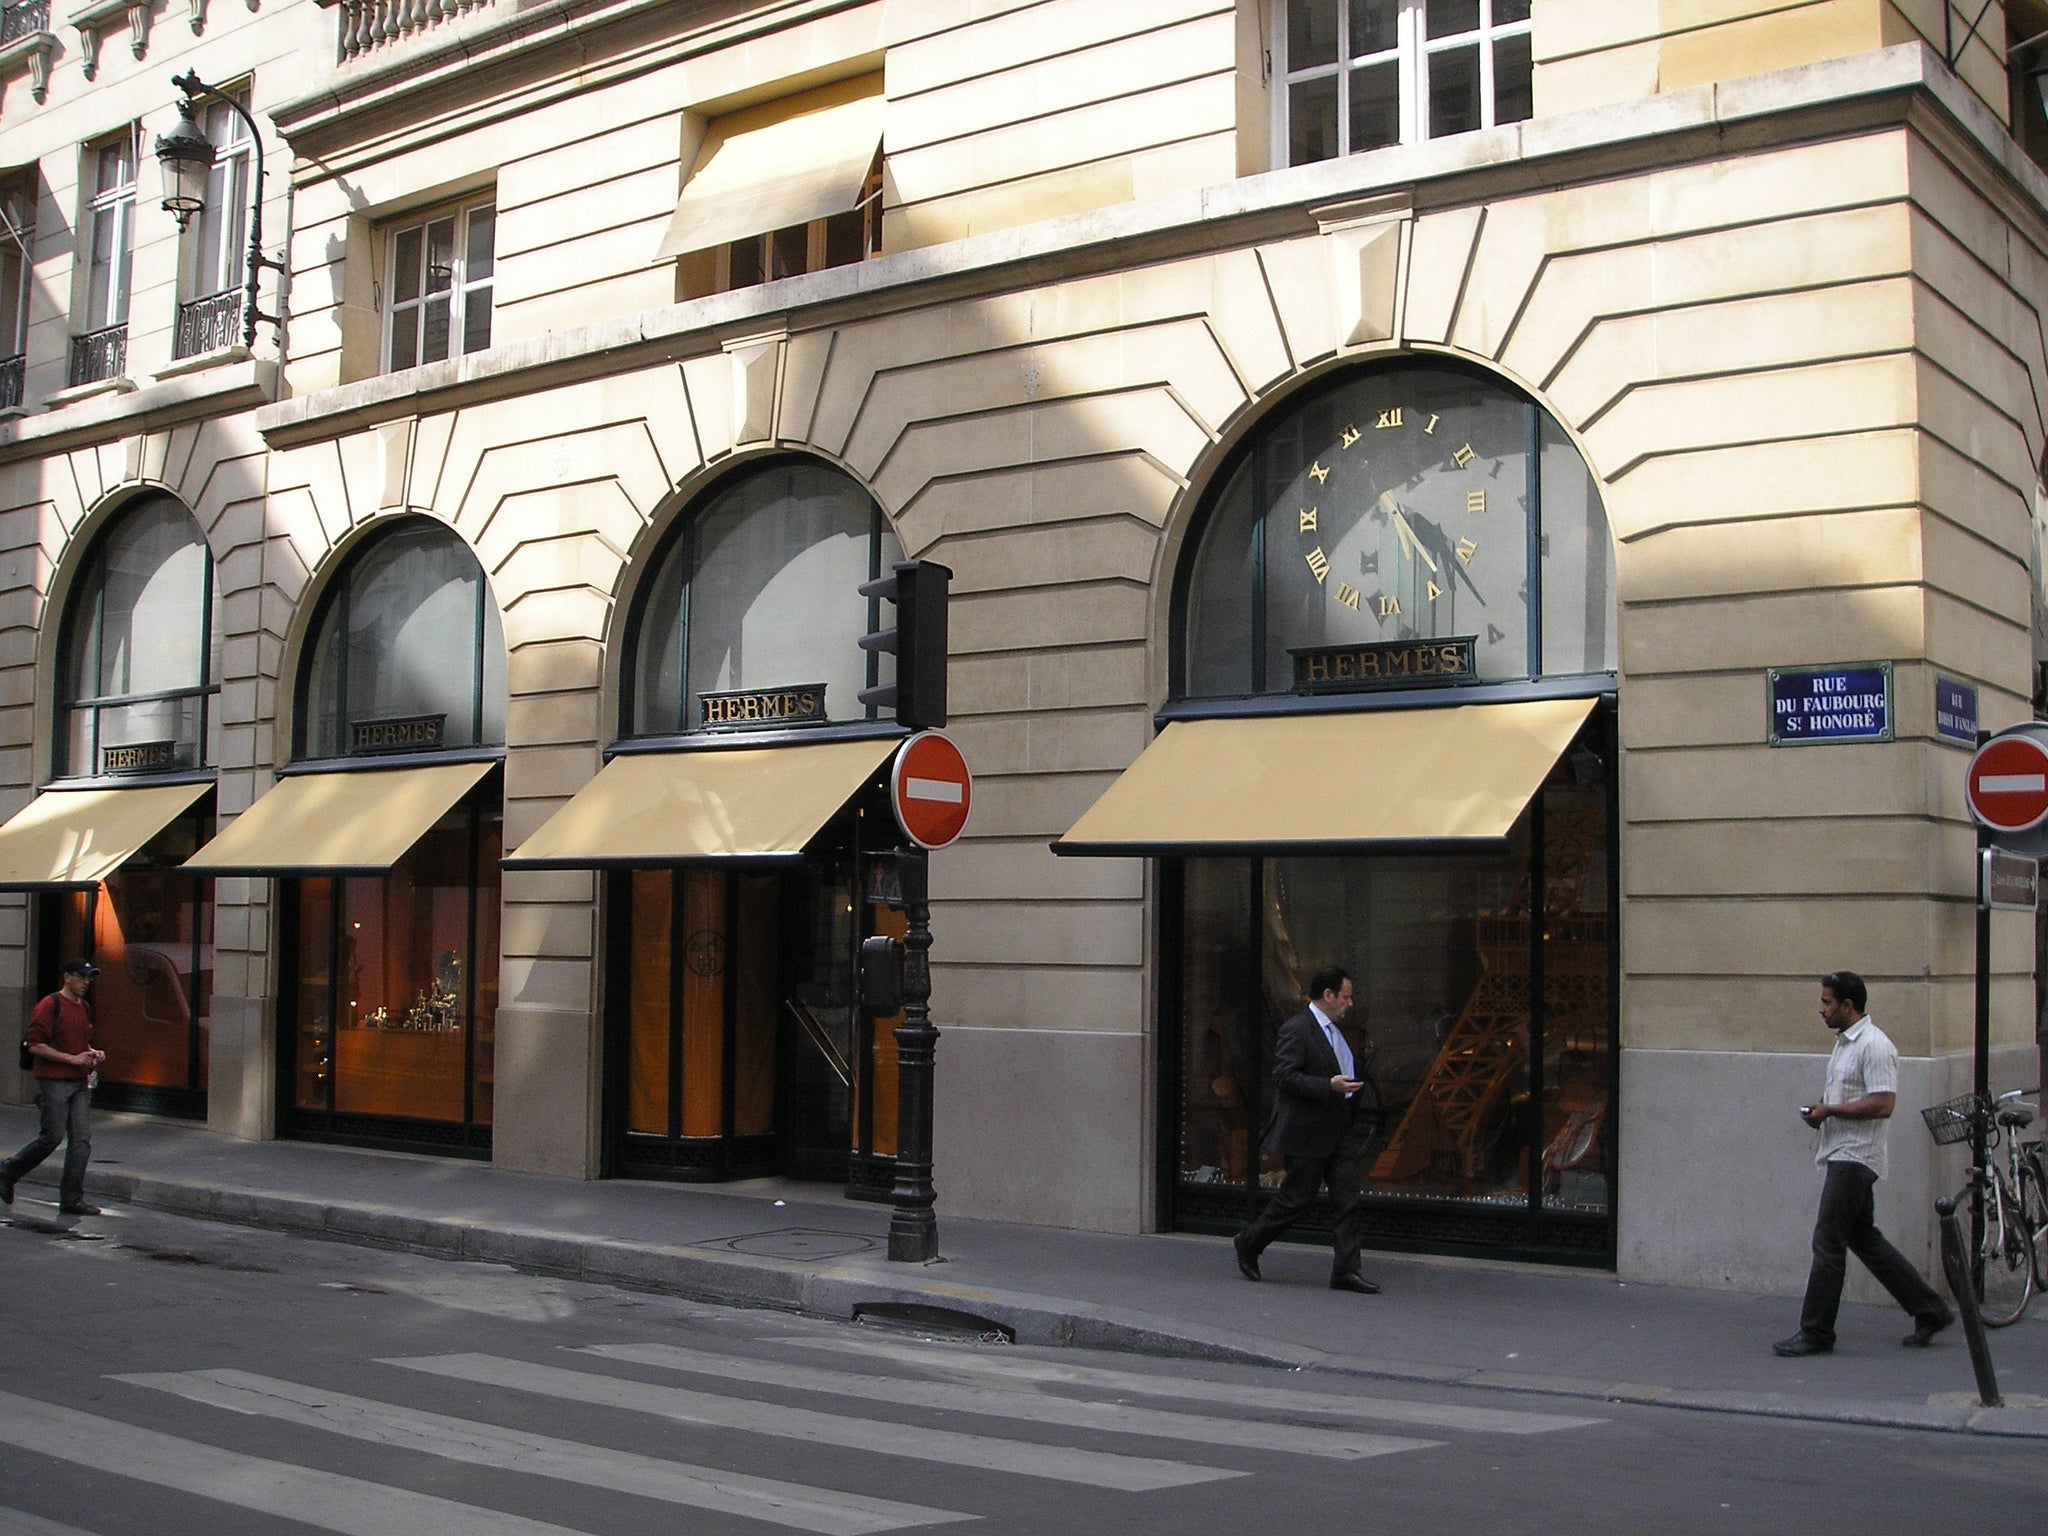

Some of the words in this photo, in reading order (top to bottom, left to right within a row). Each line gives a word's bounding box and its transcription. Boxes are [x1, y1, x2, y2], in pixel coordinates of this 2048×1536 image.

[1375, 407, 1403, 429] XII
[1338, 422, 1362, 450] XI
[1452, 442, 1476, 469] II
[1308, 460, 1330, 485] X
[1467, 488, 1487, 514] III
[1300, 506, 1318, 533] IX
[1455, 536, 1478, 567] IV
[1305, 546, 1332, 585] VIII
[1334, 581, 1361, 612] VII
[1426, 580, 1444, 601] V
[1378, 595, 1402, 616] VI
[1307, 644, 1461, 681] HERMÈS
[1812, 677, 1847, 693] RUE
[1776, 698, 1797, 714] DU
[1803, 693, 1885, 713] FAUBOURG
[1809, 708, 1875, 730] HONORÉ
